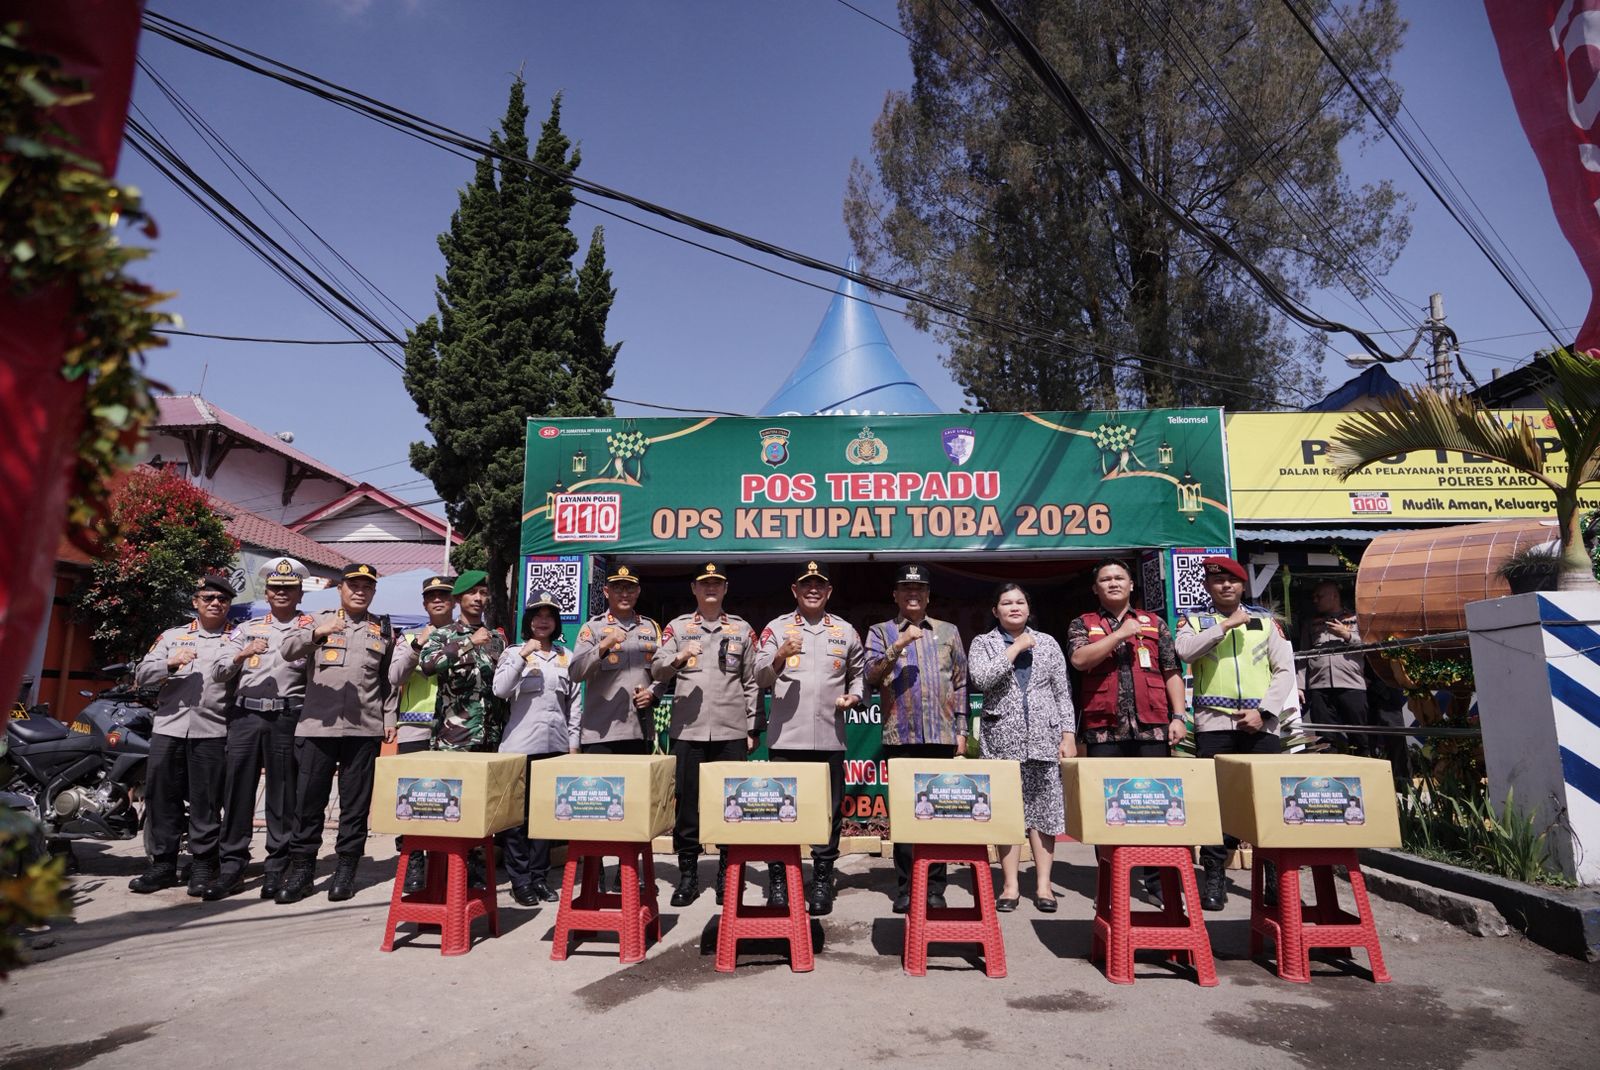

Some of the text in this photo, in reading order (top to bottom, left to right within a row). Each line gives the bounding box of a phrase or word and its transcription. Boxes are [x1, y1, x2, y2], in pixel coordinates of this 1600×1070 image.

[1167, 416, 1209, 424] Telkomsel
[1280, 467, 1319, 475] DALAM
[1376, 467, 1444, 475] PELAYANAN
[1448, 466, 1511, 474] PERAYAAN
[742, 471, 1000, 502] POS TERPADU
[1438, 475, 1538, 486] POLRES KARO
[1355, 500, 1387, 510] 110
[1402, 497, 1557, 513] Mudik Aman, Keluarga
[561, 506, 616, 532] 110
[651, 504, 1112, 540] OPS KETUPAT TOBA 2026
[828, 638, 847, 646] POLRI
[69, 720, 92, 735] POLISI
